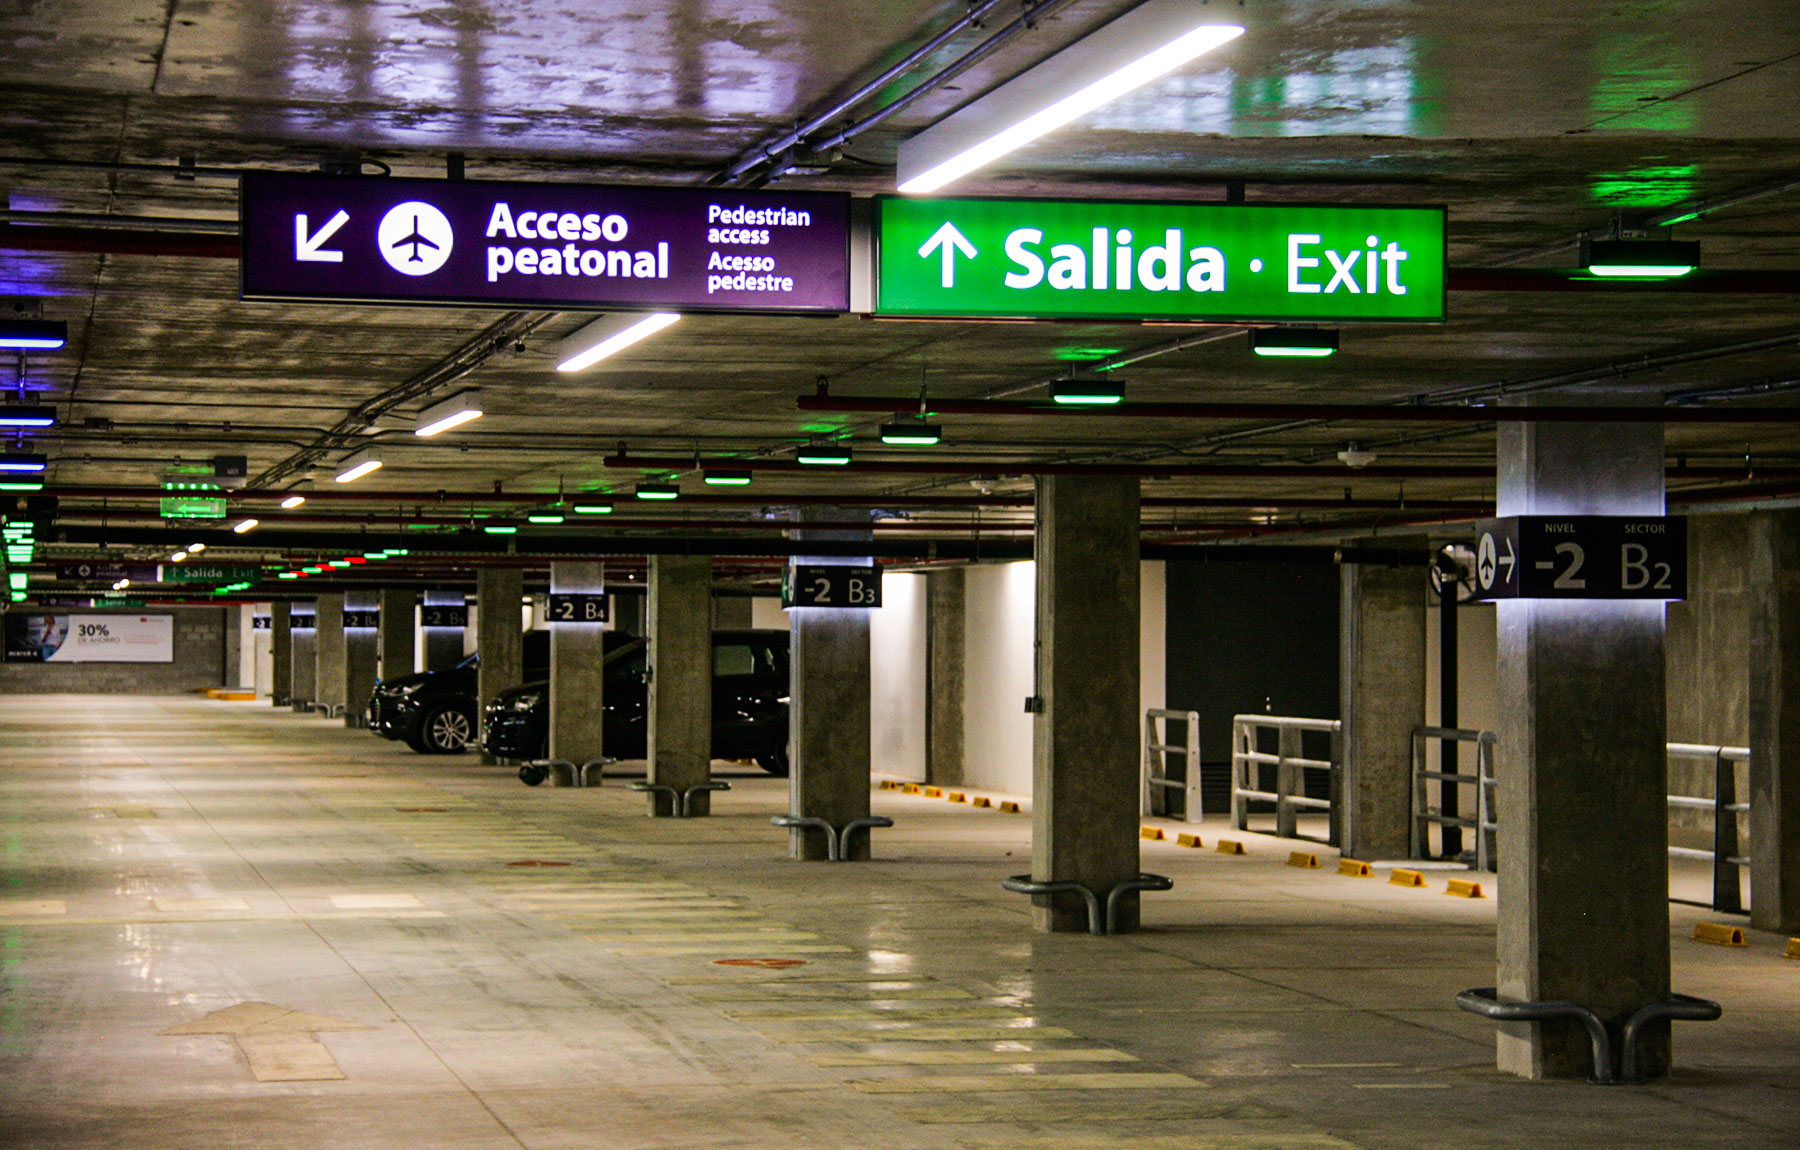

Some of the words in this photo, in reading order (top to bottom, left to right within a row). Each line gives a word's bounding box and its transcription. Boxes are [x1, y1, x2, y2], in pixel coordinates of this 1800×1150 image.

[486, 202, 628, 242] Acceso
[708, 204, 811, 227] Pedestrian
[708, 228, 770, 246] access
[487, 241, 669, 282] peatonal
[708, 251, 775, 272] Acesso
[1004, 227, 1225, 293] Salida
[1287, 233, 1408, 295] Exit
[708, 272, 793, 294] pedestre
[1545, 523, 1575, 533] NIVEL
[1624, 524, 1665, 534] SECTOR
[184, 566, 223, 578] Salida
[233, 567, 254, 578] Exit
[1535, 542, 1586, 589] -2
[1621, 543, 1671, 589] B2
[804, 578, 831, 602] -2
[849, 579, 875, 603] B3
[555, 602, 574, 619] -2
[585, 602, 604, 619] B4
[78, 624, 110, 637] 30%
